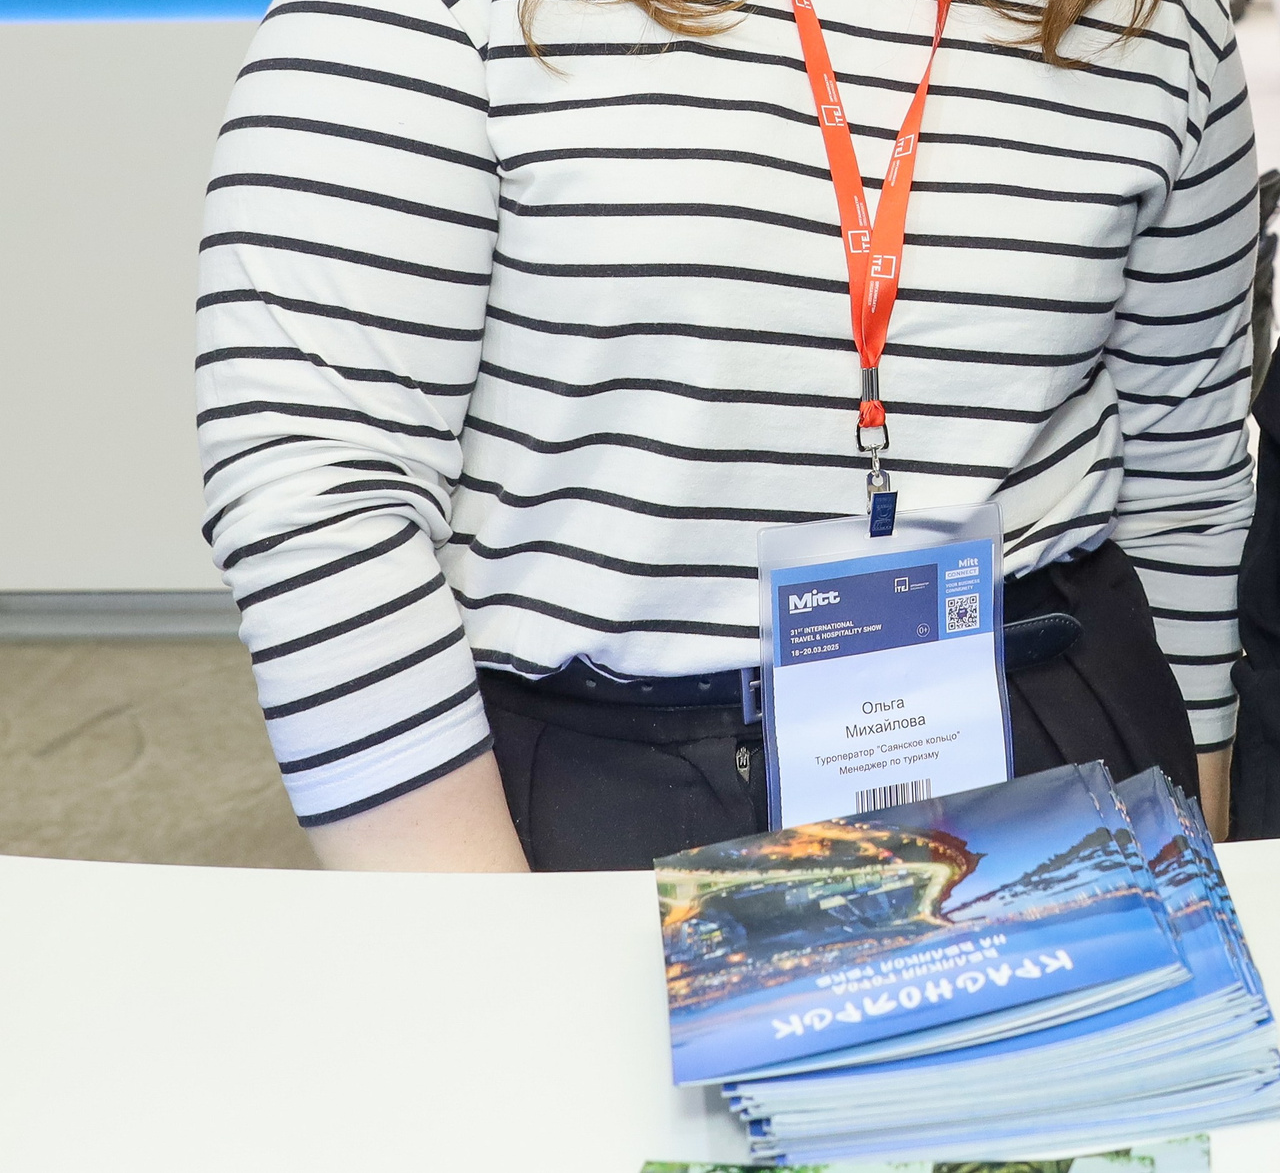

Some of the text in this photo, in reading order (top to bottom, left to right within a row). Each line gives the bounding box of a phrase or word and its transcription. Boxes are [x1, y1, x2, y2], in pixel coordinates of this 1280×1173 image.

[958, 557, 979, 568] Mitt
[947, 568, 977, 578] CONNECT
[788, 589, 841, 612] Mitt
[790, 634, 815, 644] TRAVEL
[821, 627, 862, 640] HOSPITALITY
[863, 624, 883, 633] SHOW
[804, 620, 855, 634] INTERNATIONAL
[861, 698, 905, 715] Ольга
[845, 715, 926, 739] Михайлова
[814, 747, 875, 766] Туроператор
[839, 750, 940, 775] Менеджер по туризму
[771, 949, 1074, 1040] КРАСНОЯРСК
